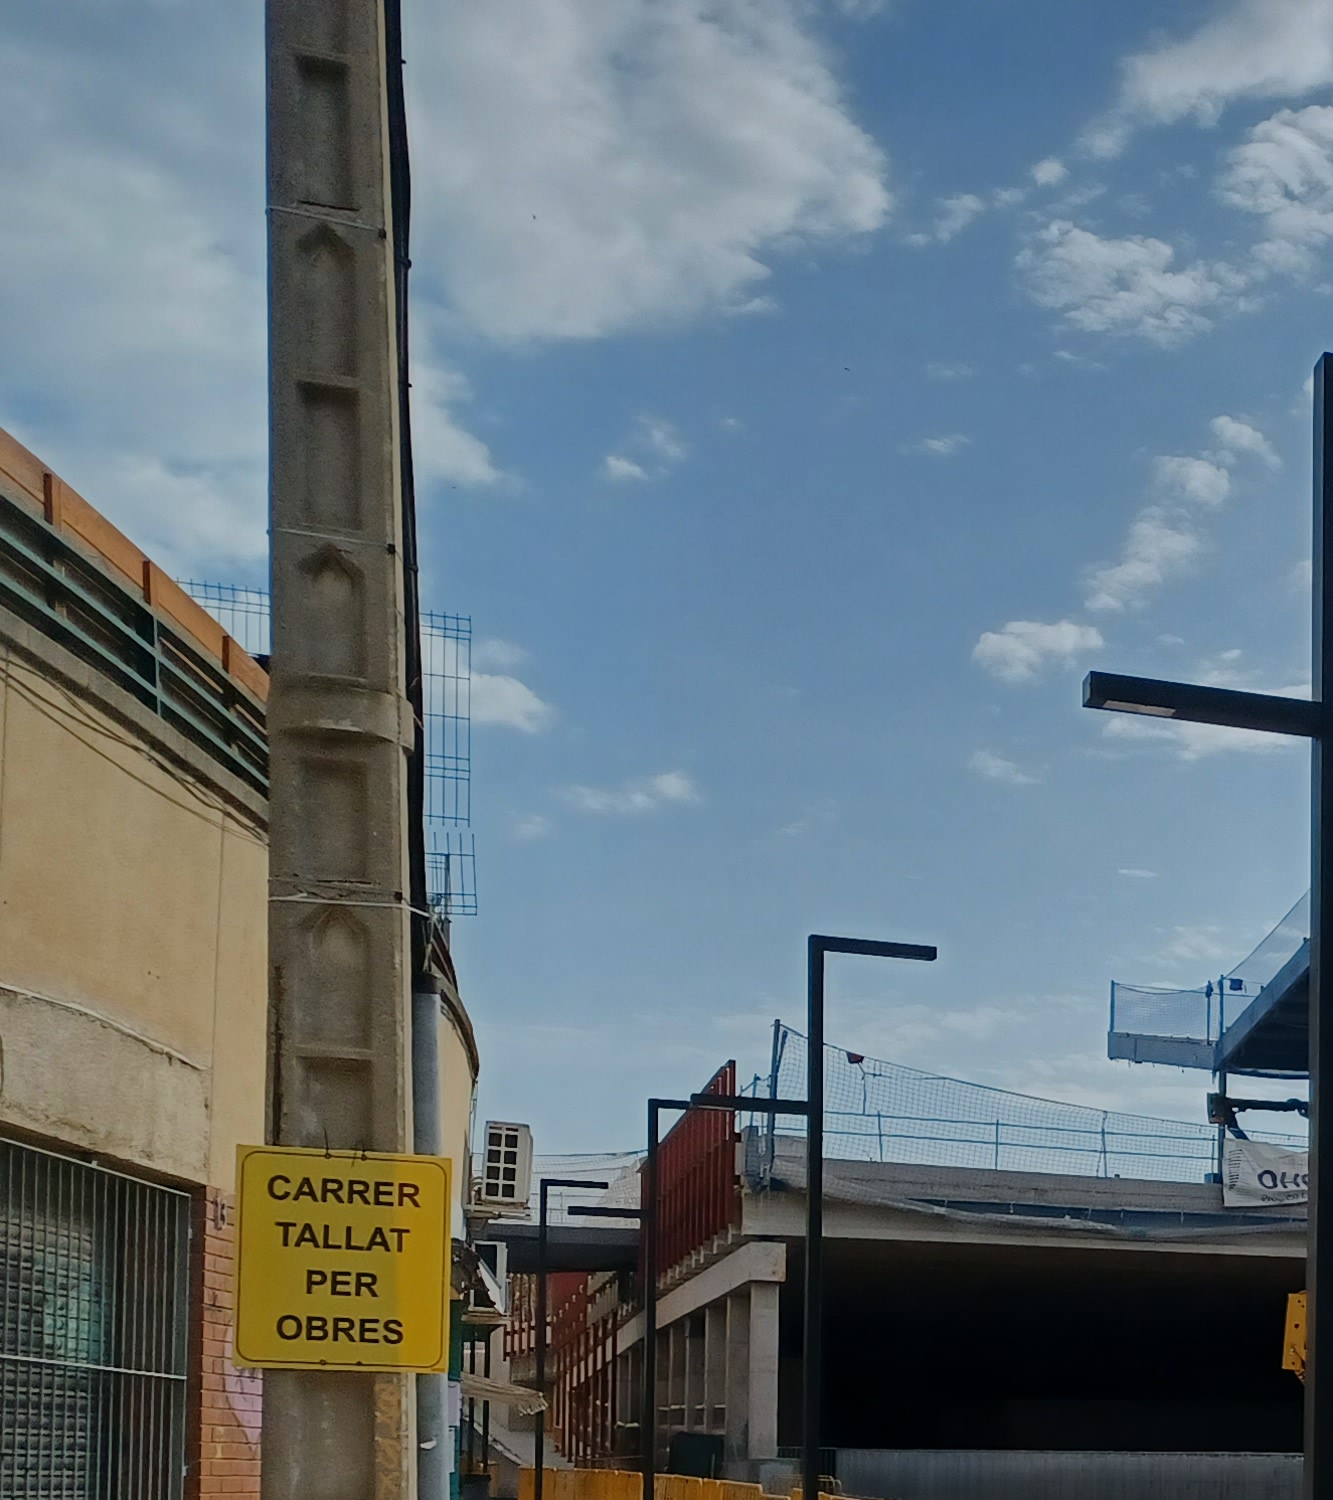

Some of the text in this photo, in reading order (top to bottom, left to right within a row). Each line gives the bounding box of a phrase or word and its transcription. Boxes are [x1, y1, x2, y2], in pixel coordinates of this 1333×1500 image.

[267, 1174, 421, 1209] CARRER
[274, 1221, 411, 1253] TALLAT
[306, 1269, 379, 1298] PER
[276, 1314, 404, 1345] OBRES
